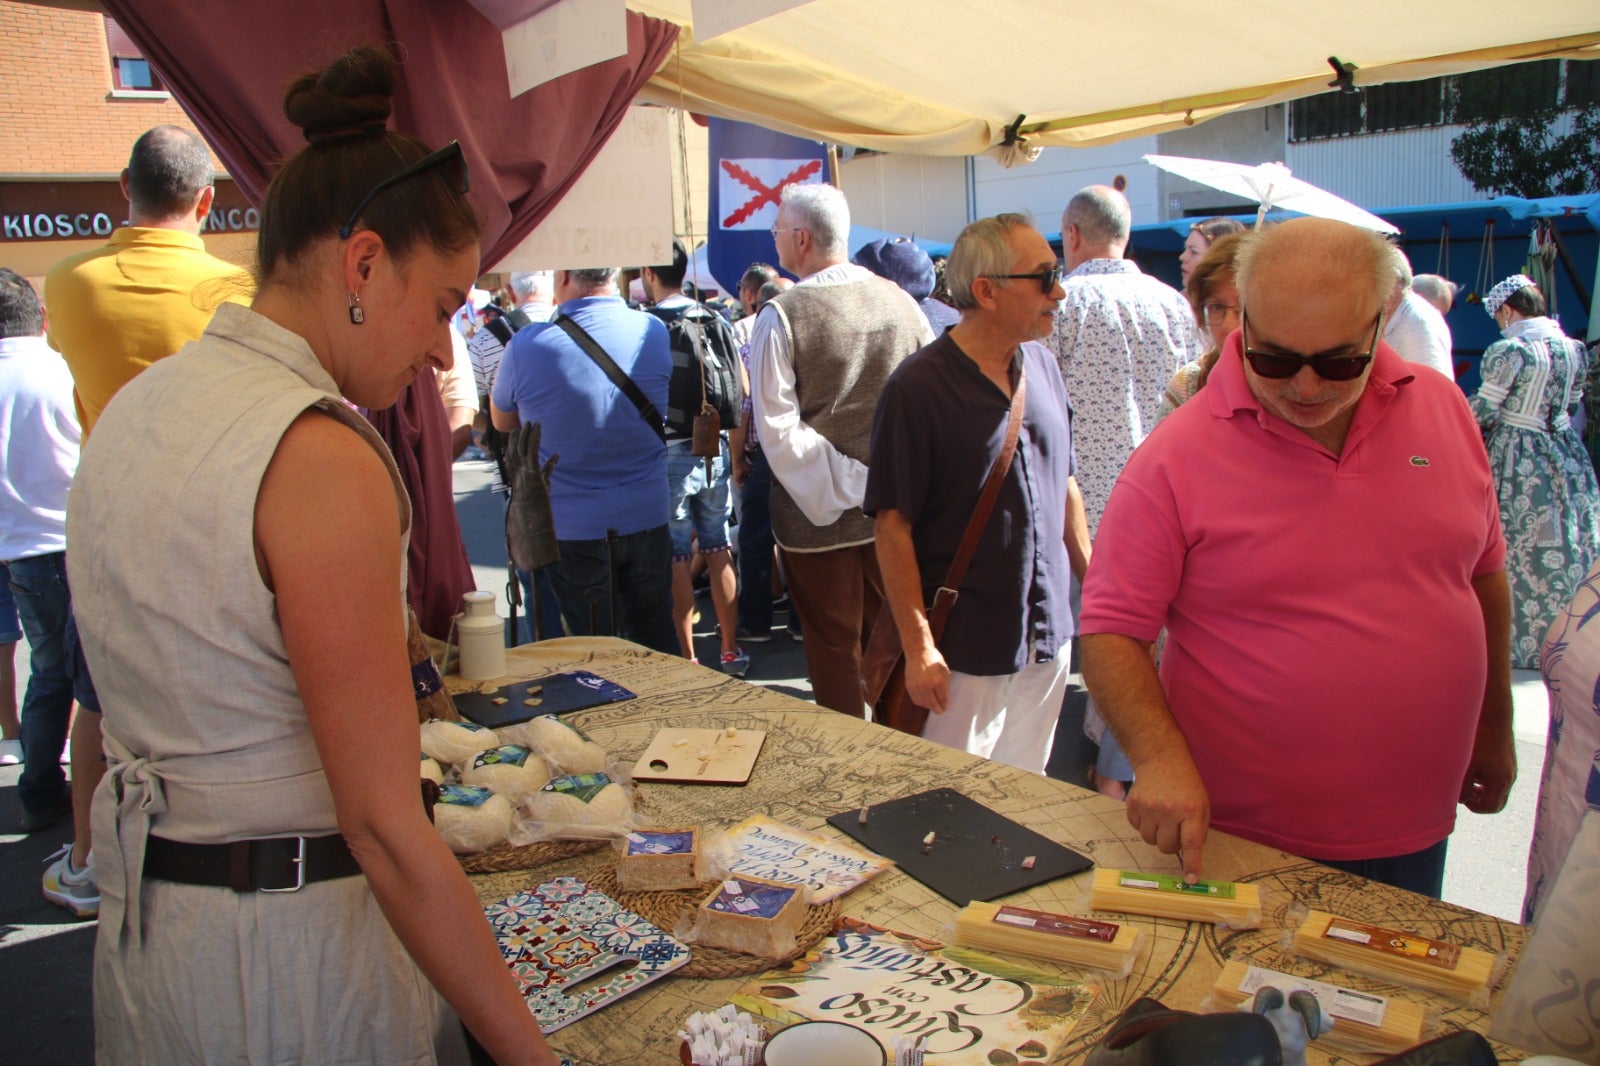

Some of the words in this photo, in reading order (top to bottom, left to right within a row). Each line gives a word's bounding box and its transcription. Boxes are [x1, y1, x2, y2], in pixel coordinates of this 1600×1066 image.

[3, 212, 112, 238] KIOSCO
[823, 933, 1034, 1016] Castañas
[880, 985, 931, 1006] con
[819, 991, 983, 1056] Queso
